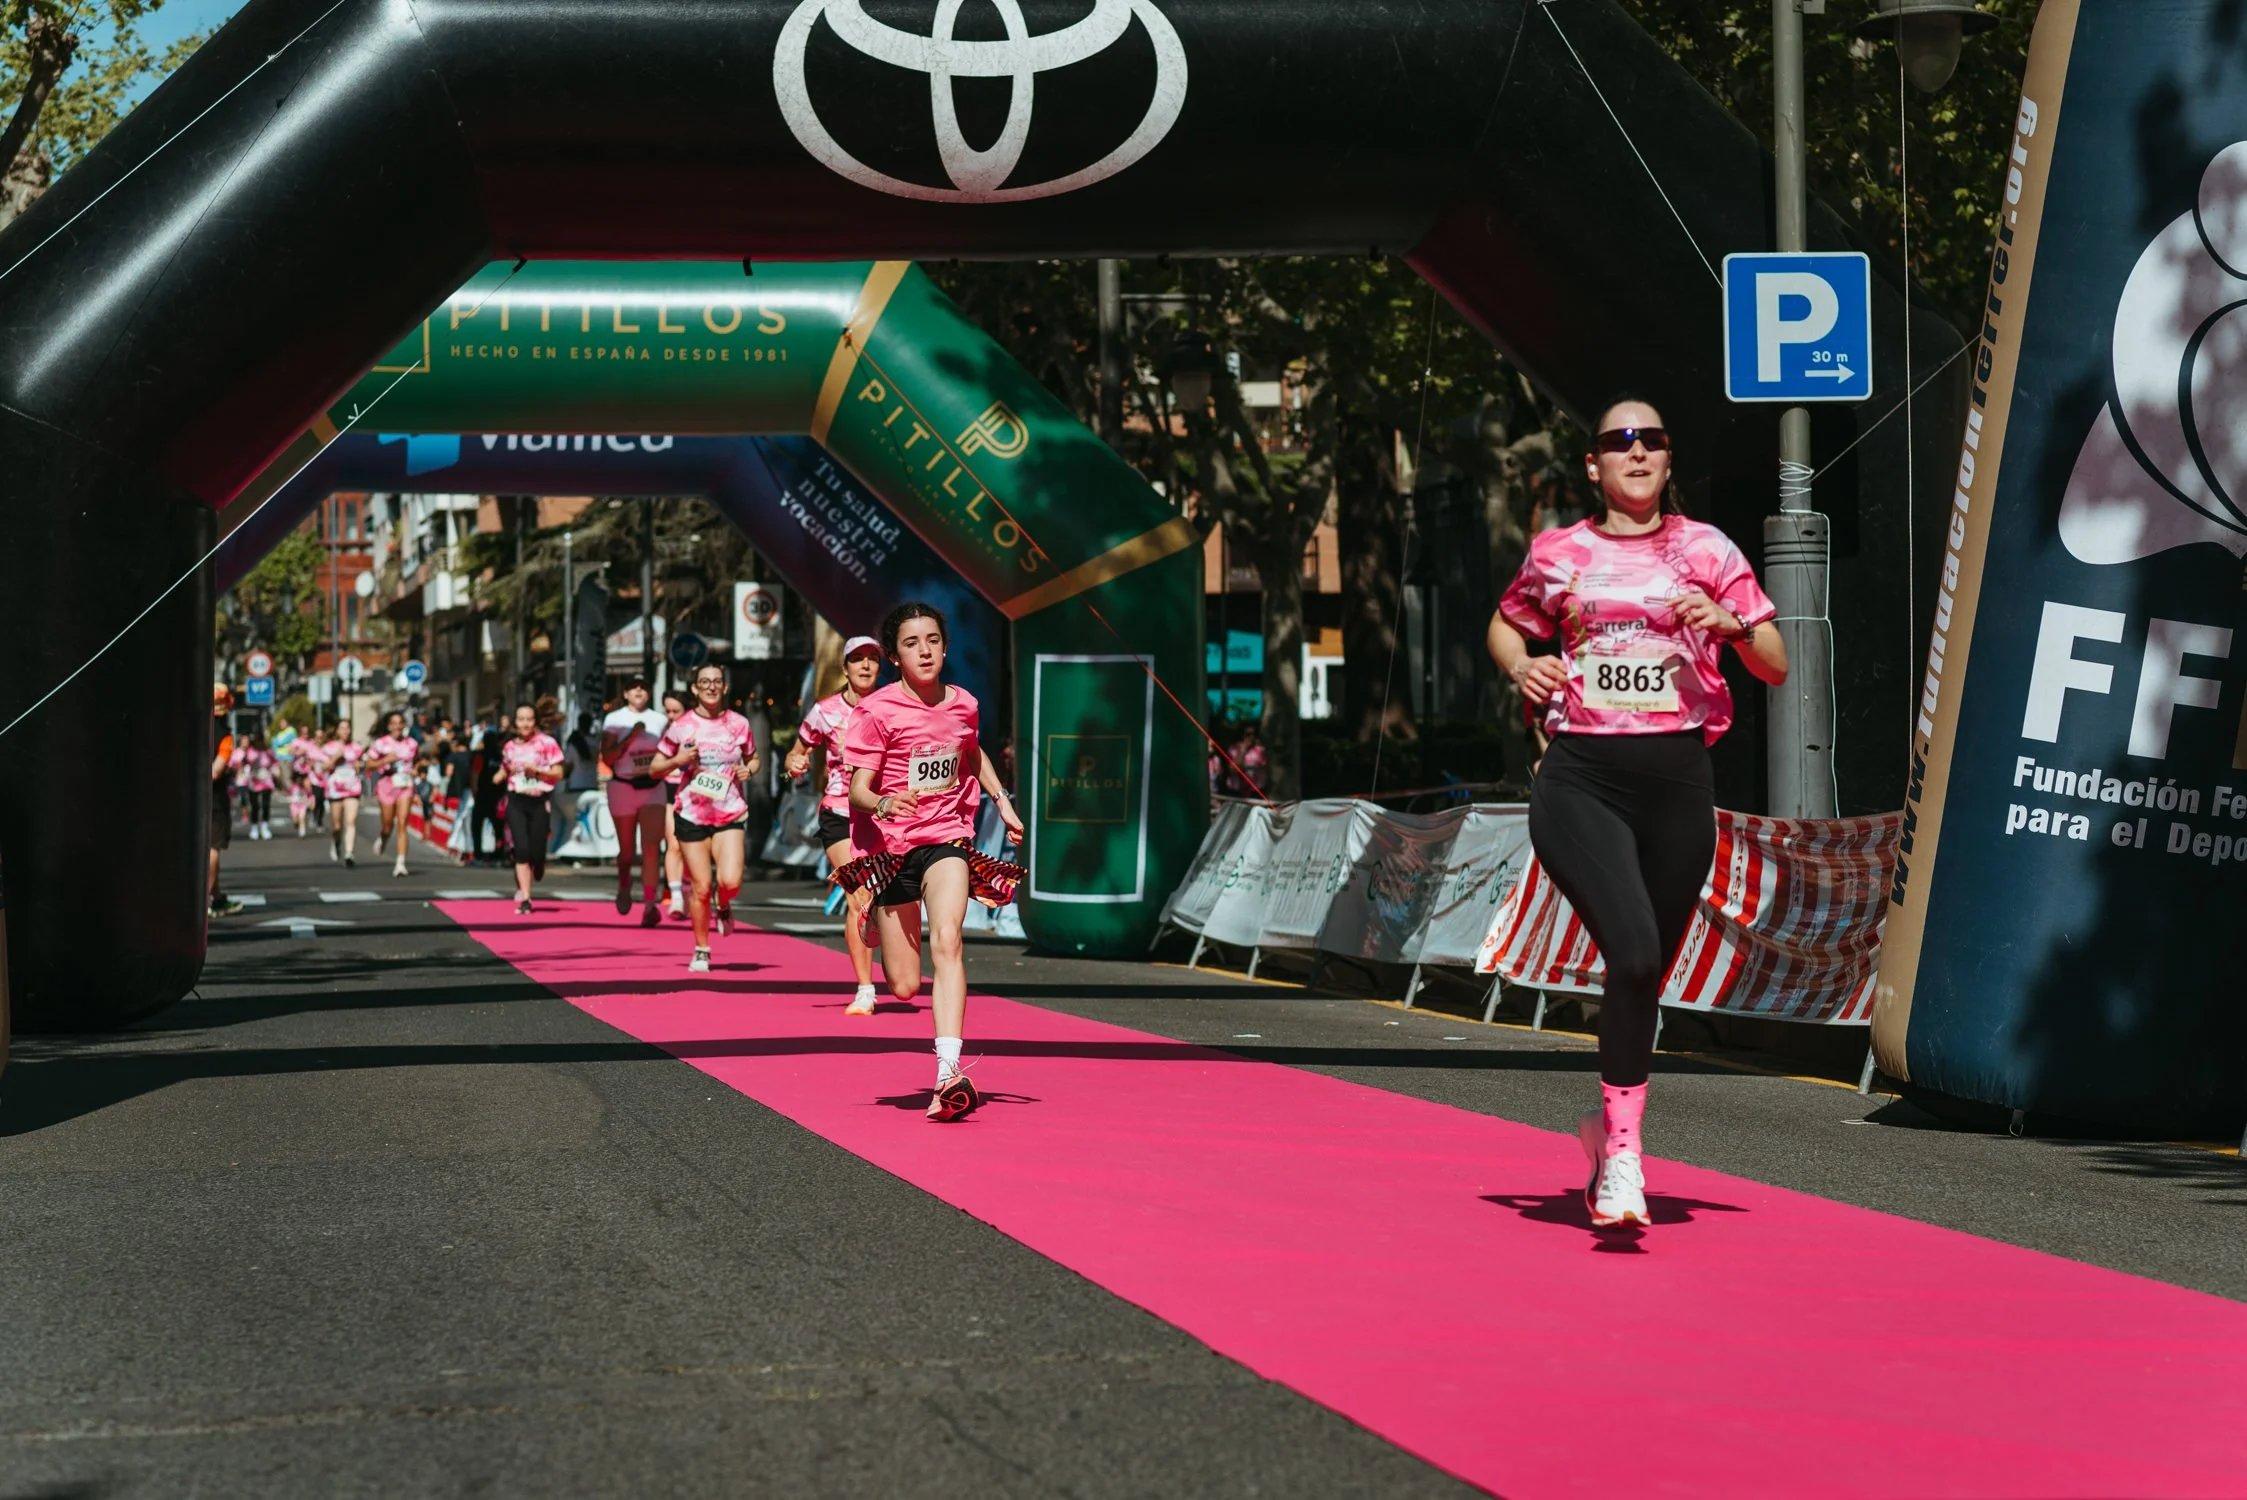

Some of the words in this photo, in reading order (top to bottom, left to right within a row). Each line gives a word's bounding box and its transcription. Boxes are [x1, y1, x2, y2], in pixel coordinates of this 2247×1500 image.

[1755, 272, 1839, 383] P
[450, 345, 519, 359] HECHO
[533, 346, 557, 360] EN
[570, 345, 650, 360] ESPAÑA
[664, 348, 730, 361] DESDE
[744, 349, 788, 361] 1981
[1812, 351, 1831, 362] 30
[1836, 353, 1848, 362] m
[858, 378, 1043, 573] PITILLOS
[798, 479, 886, 566] nuestra
[813, 456, 842, 492] Tu
[841, 486, 900, 552] salud,
[779, 490, 867, 584] vocación.
[1581, 601, 1597, 615] XI
[1585, 617, 1645, 634] Carrera
[1598, 664, 1666, 692] 8863
[2021, 601, 2247, 768] FF
[697, 775, 723, 791] 6359
[918, 757, 958, 781] 9880
[2013, 755, 2200, 814] Fundación
[2005, 803, 2090, 841] para
[2111, 817, 2148, 849] el
